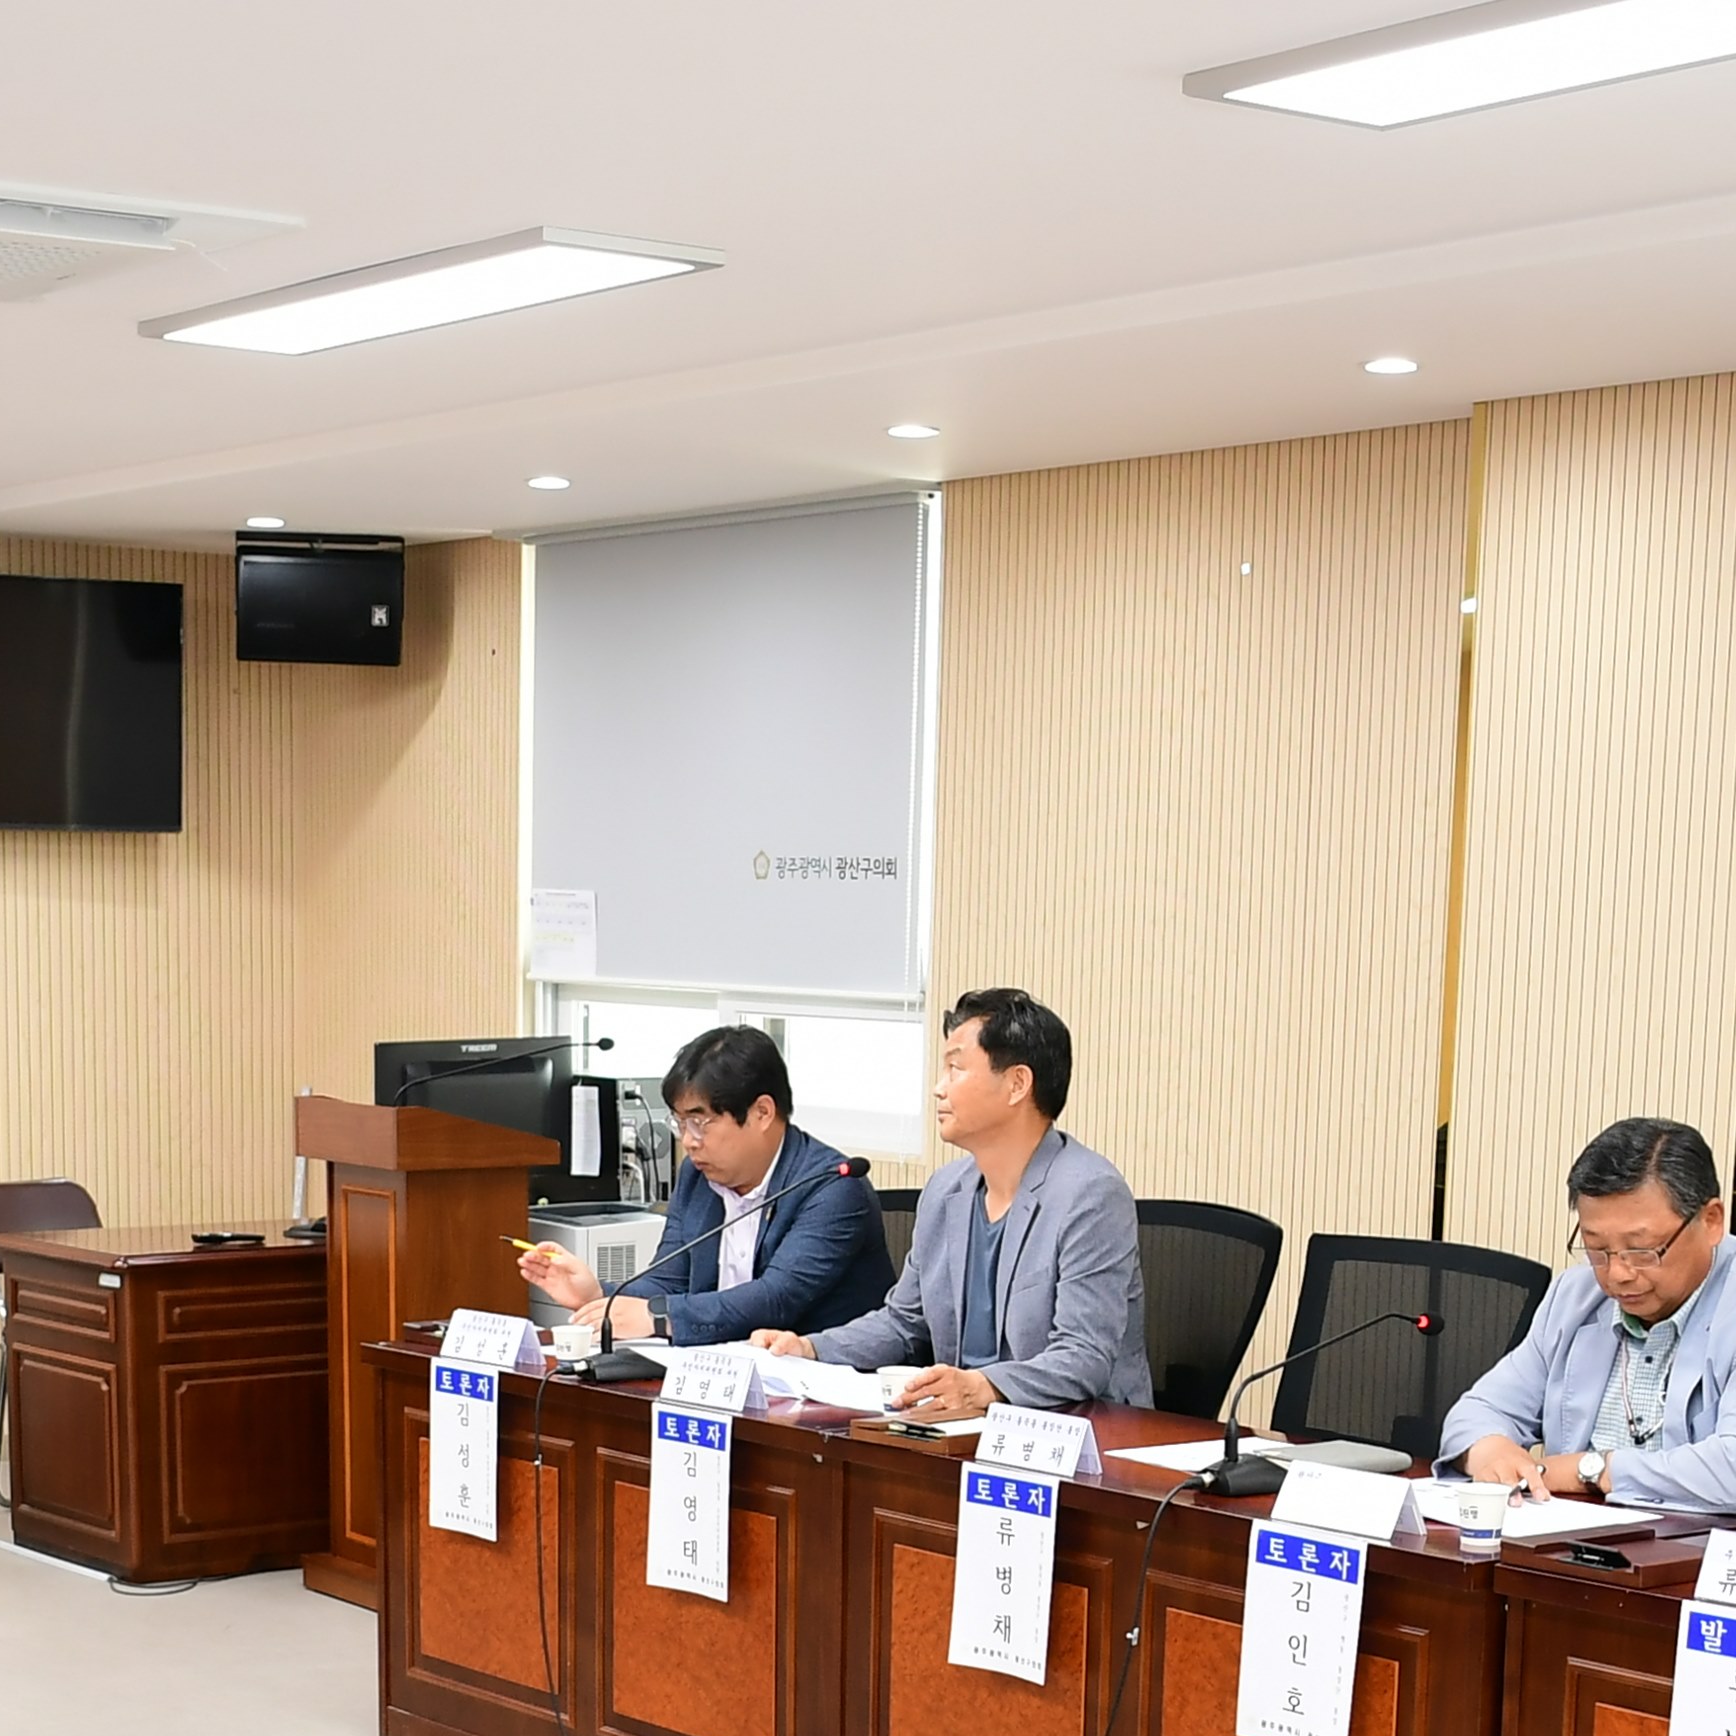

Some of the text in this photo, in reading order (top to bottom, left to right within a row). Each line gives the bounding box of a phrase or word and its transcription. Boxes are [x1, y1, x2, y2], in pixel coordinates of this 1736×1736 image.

[775, 856, 897, 880] 광주광역시 광산구의회
[440, 1371, 490, 1401] 토론자
[675, 1375, 736, 1403] 김영태
[664, 1416, 721, 1449] 토론자
[992, 1434, 1065, 1468] 류병채
[974, 1478, 1046, 1514] 토론자
[1264, 1537, 1351, 1581] 토론자
[993, 1517, 1015, 1644] 류병채
[1282, 1581, 1311, 1715] 김인호
